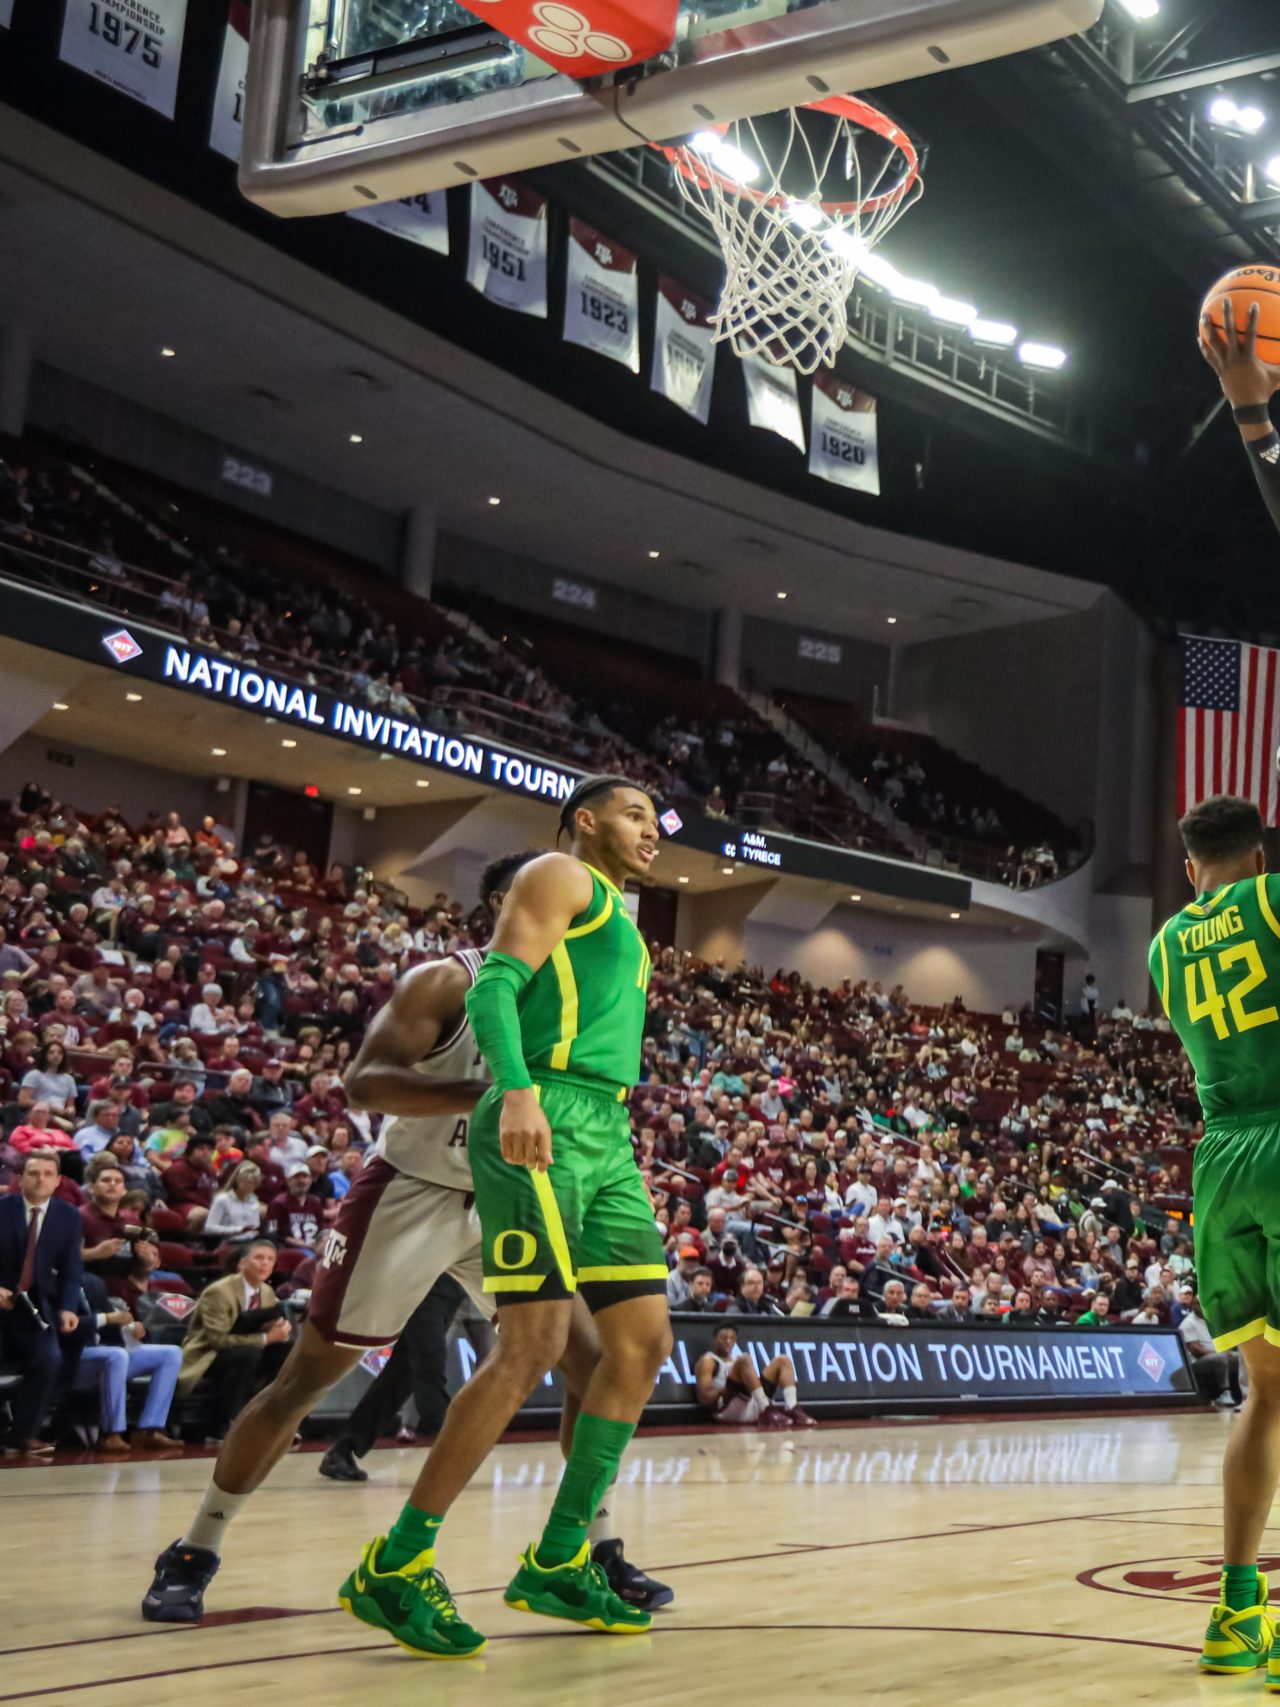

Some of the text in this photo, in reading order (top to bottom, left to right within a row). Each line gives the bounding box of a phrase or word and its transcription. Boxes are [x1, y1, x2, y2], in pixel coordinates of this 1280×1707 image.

[88, 2, 164, 69] 1975
[481, 236, 527, 283] 1951
[580, 292, 629, 335] 1923
[820, 432, 866, 465] 1920
[164, 645, 576, 801] NATIONAL INVITATION TOURN
[743, 847, 781, 866] TYRECE
[1177, 904, 1245, 956] YOUNG
[1184, 939, 1280, 1041] 42
[493, 1229, 538, 1270] O
[731, 1341, 922, 1383] NVITATION
[928, 1342, 1126, 1382] TOURNAMENT
